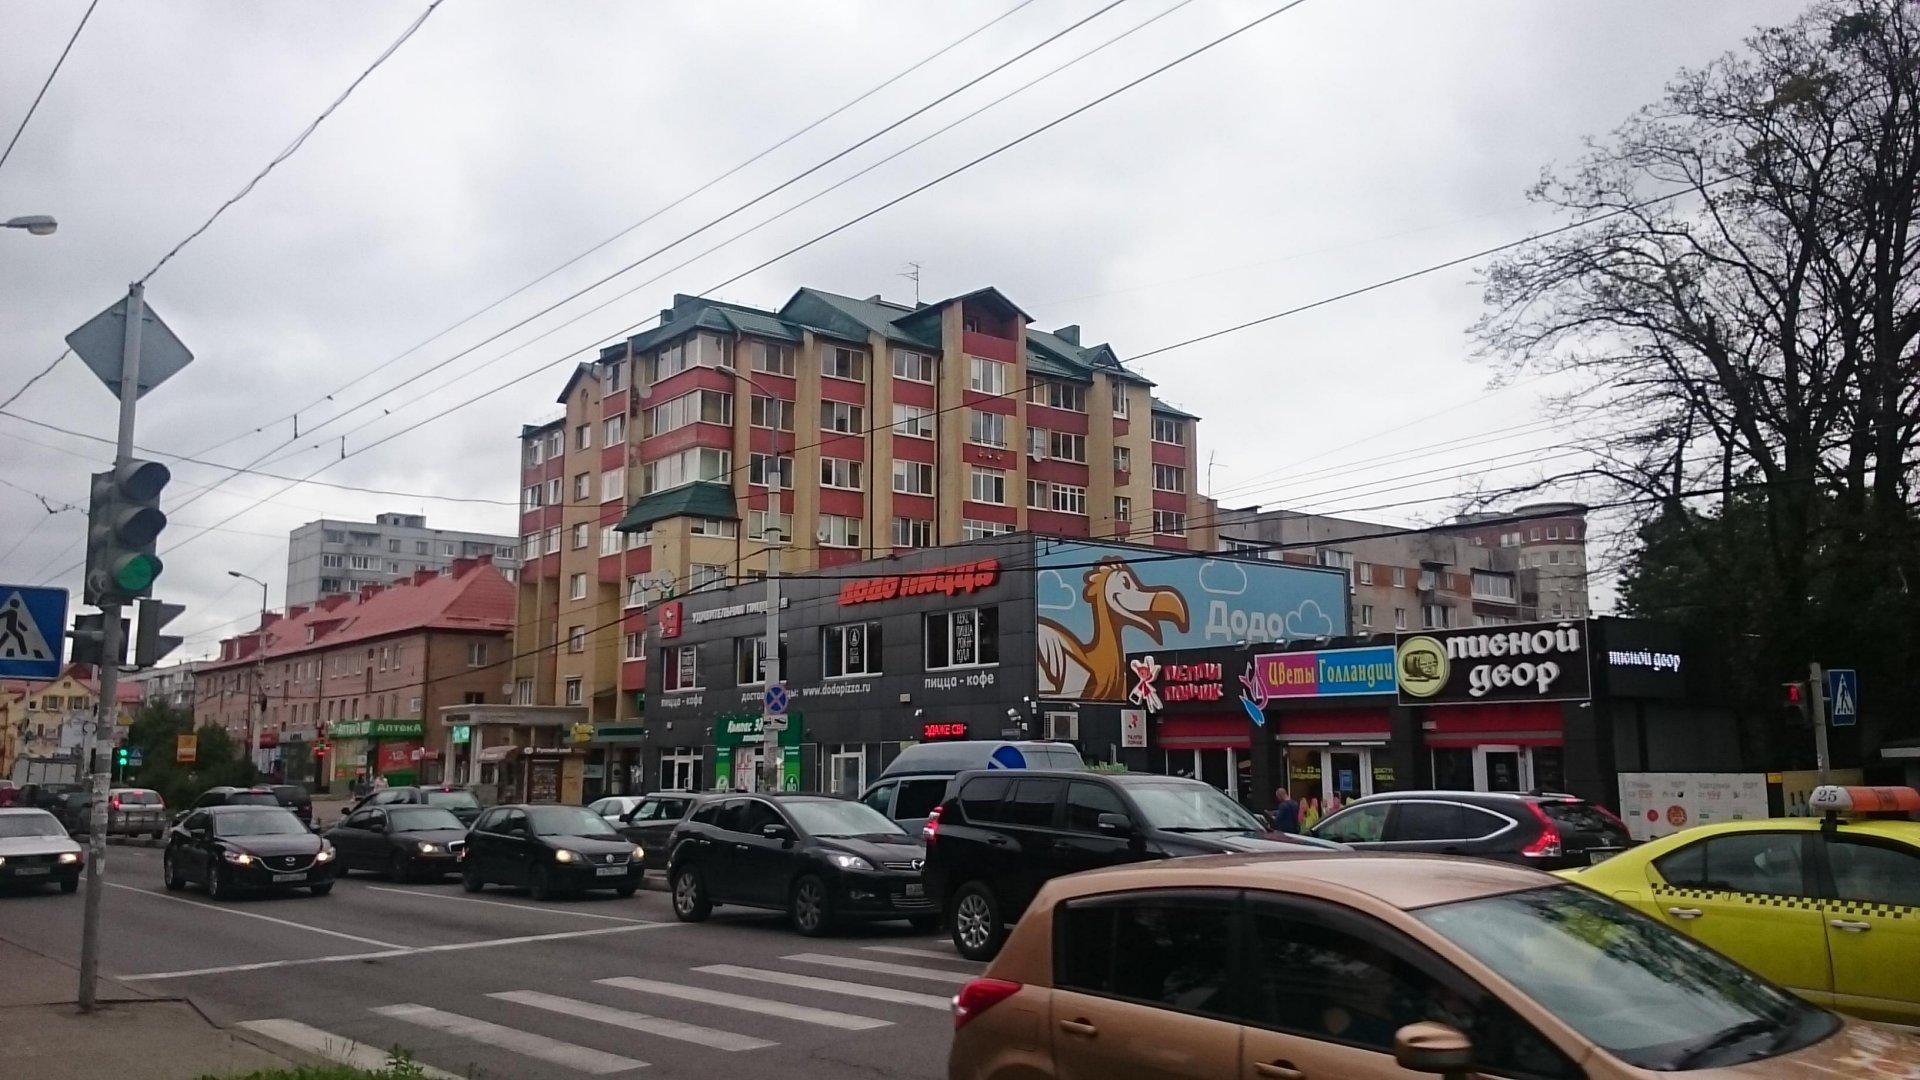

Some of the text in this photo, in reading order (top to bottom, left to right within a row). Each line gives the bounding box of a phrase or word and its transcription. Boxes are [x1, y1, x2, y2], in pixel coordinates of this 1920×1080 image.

[1205, 600, 1284, 642] Додо
[925, 674, 957, 690] пицца
[967, 671, 994, 688] кофе
[1268, 658, 1393, 687] Цветы Голландии
[803, 681, 871, 697] www.dodopizza.ru
[1817, 789, 1837, 802] 25
